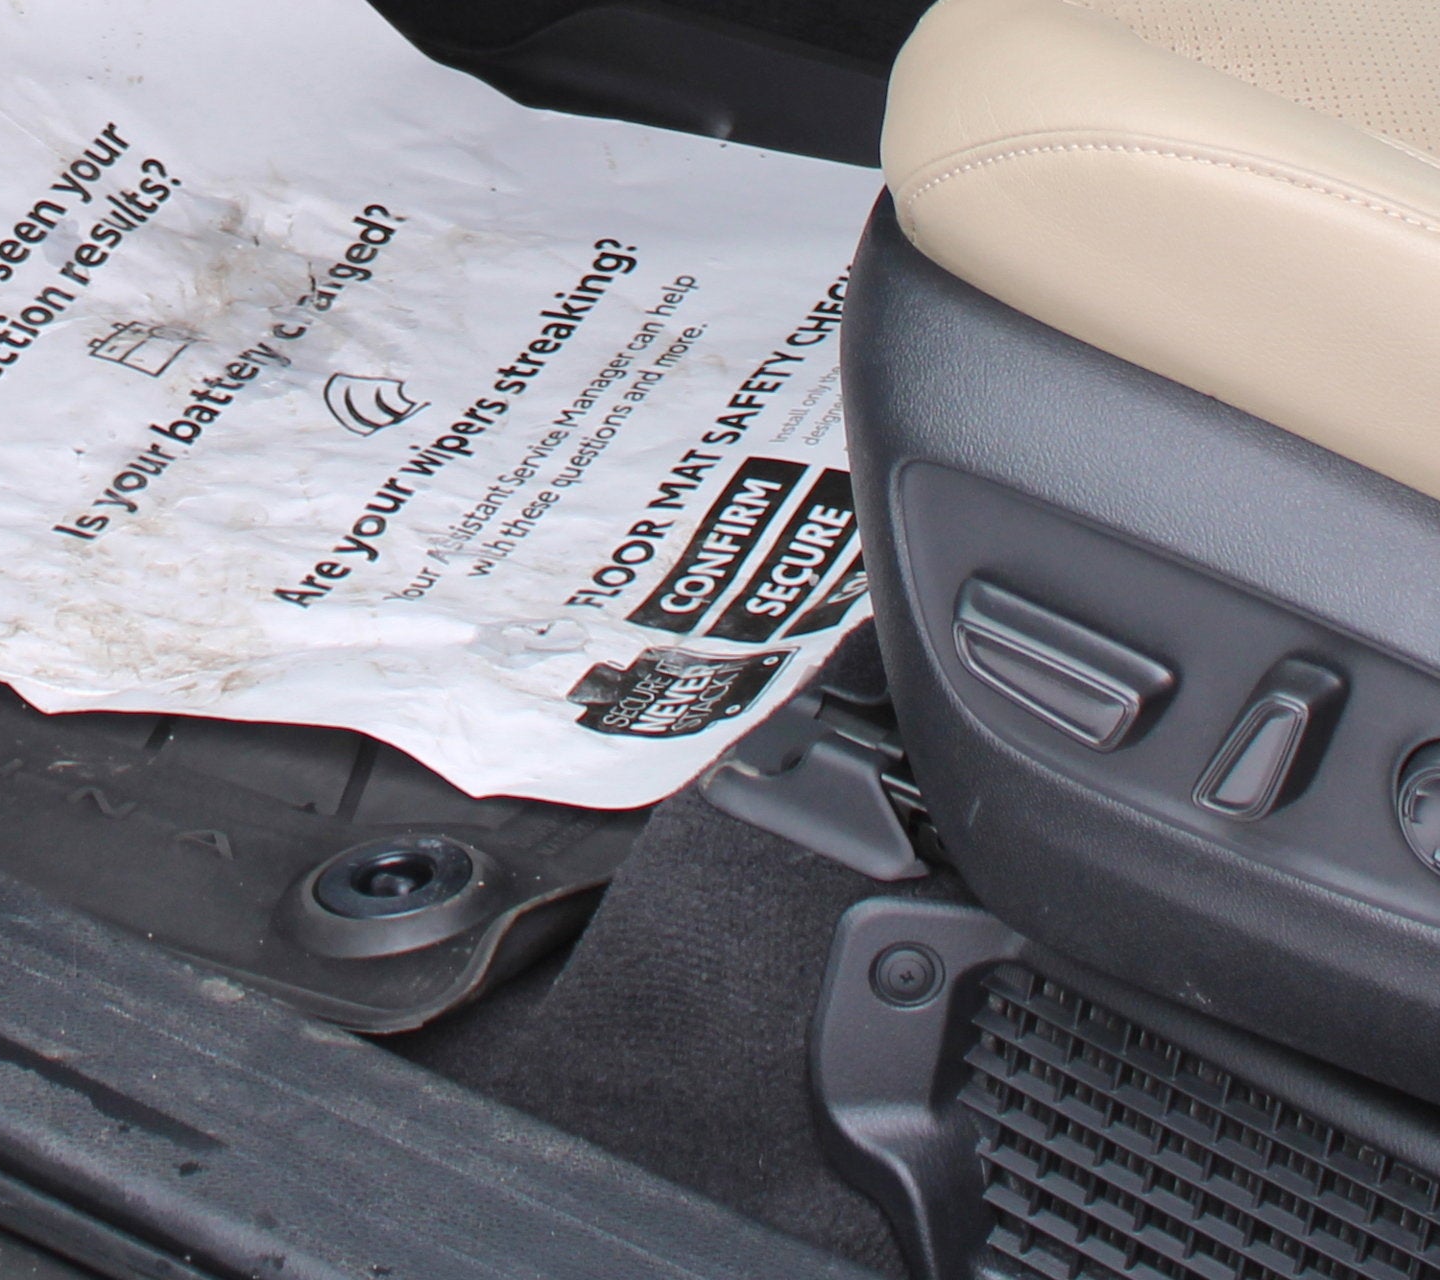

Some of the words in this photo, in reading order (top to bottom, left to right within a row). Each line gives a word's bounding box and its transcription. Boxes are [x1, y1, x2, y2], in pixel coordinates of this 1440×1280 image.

[51, 121, 130, 204] your
[60, 157, 182, 287] results?
[627, 314, 665, 353] can
[645, 272, 700, 319] help
[272, 558, 352, 609] Are
[333, 476, 416, 563] your
[400, 396, 510, 479] wipers
[493, 237, 639, 395] streaking?
[553, 347, 636, 428] Manager
[767, 408, 811, 443] Install
[802, 384, 833, 408] only
[51, 514, 110, 541] Is
[93, 442, 178, 514] your
[148, 341, 293, 447] battery
[496, 428, 569, 489] Service
[499, 489, 561, 539] these
[551, 403, 634, 491] questions
[622, 368, 665, 407] and
[654, 321, 709, 373] more.
[563, 517, 676, 610] FLOOR
[645, 447, 725, 512] MAT
[699, 349, 805, 448] SAFETY
[382, 566, 442, 602] Your
[658, 476, 783, 615] CONFIRM
[744, 503, 854, 618] SECURE
[602, 672, 673, 728] SECURE
[629, 662, 724, 734] NEVER
[670, 670, 740, 732] STACK
